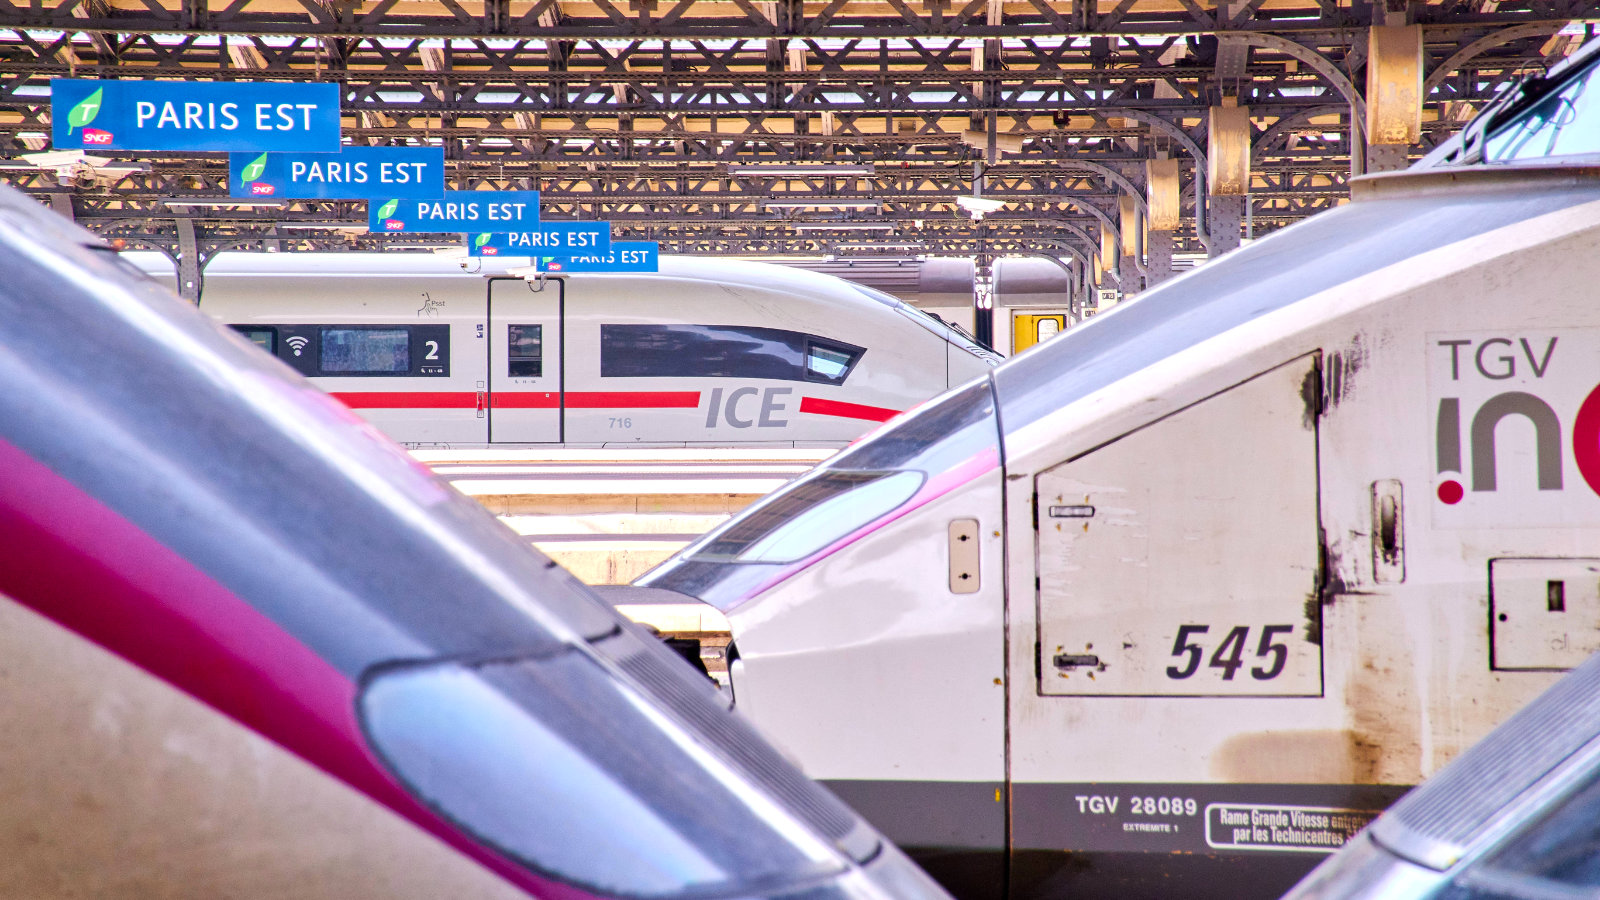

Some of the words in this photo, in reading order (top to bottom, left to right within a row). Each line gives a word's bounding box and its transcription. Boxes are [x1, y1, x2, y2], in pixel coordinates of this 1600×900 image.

[136, 101, 239, 130] PARIS
[255, 103, 318, 131] EST
[83, 132, 111, 143] SNCF
[291, 161, 368, 183] PARIS
[380, 162, 427, 184] EST
[252, 186, 273, 195] SNCF
[417, 202, 479, 220] PARIS
[488, 203, 526, 221] EST
[508, 232, 560, 247] PARIS
[567, 232, 600, 247] EST
[621, 250, 649, 264] EST
[425, 340, 439, 360] 2
[1437, 336, 1559, 381] TGV
[705, 386, 793, 429] ICE
[608, 417, 633, 429] 716
[1166, 624, 1294, 681] 545
[1075, 796, 1119, 814] TGV
[1130, 796, 1198, 816] 28089
[1123, 823, 1171, 833] EXTREMITE
[1220, 808, 1249, 825] Rame
[1251, 809, 1289, 827] Grande
[1291, 810, 1330, 829] Vitesse
[1233, 828, 1252, 845] par
[1252, 826, 1269, 842] les
[1270, 826, 1344, 845] Technicentres
